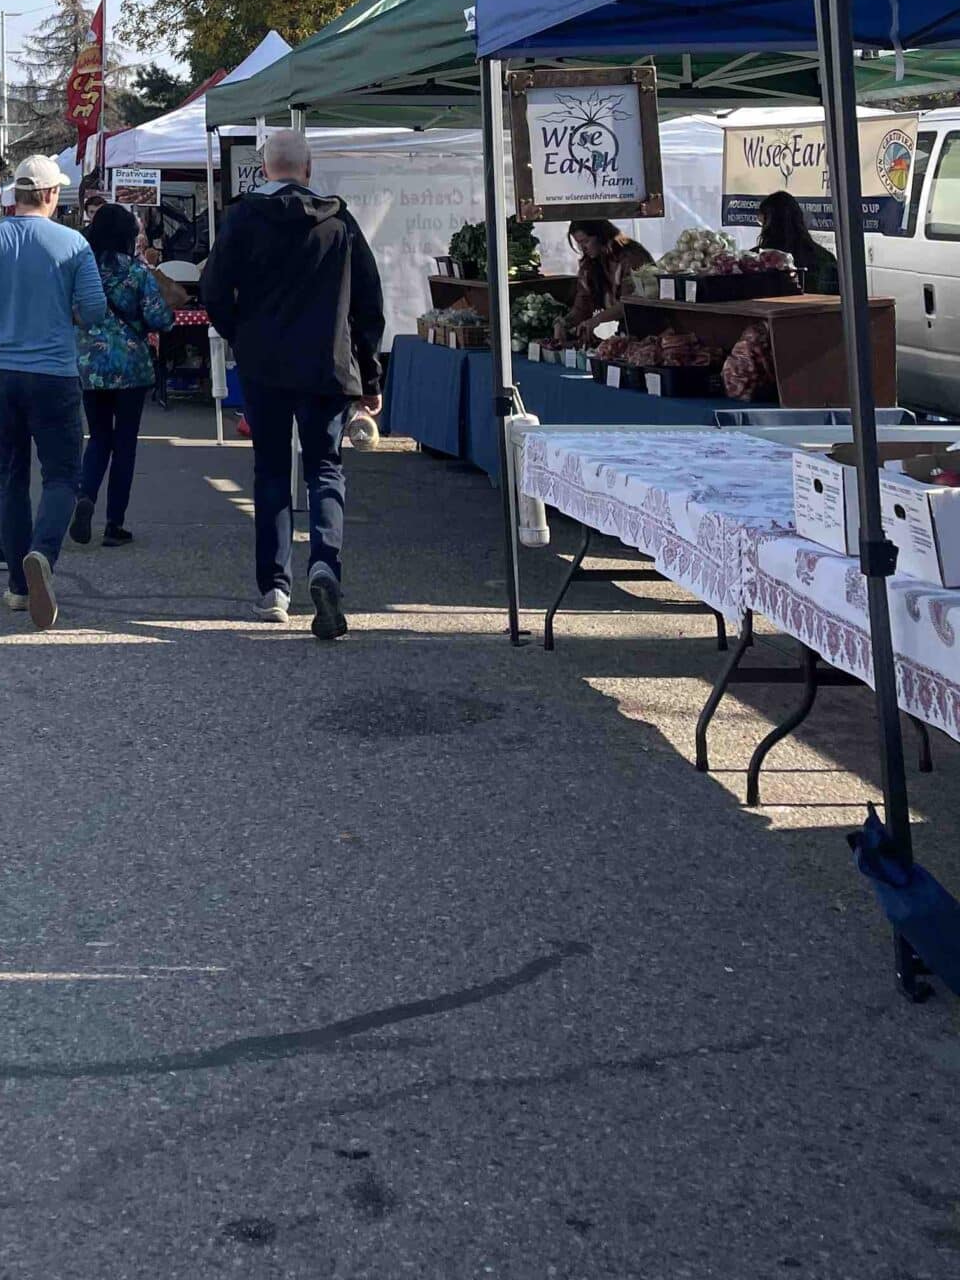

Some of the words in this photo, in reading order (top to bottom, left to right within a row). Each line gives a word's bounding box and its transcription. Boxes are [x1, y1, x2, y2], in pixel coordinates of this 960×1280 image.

[542, 125, 603, 148] Wise
[743, 135, 781, 169] Wise
[792, 134, 828, 167] Ear
[544, 151, 619, 175] Earth
[115, 169, 158, 178] Bratwurst
[601, 175, 634, 187] Farm
[868, 203, 880, 214] UP
